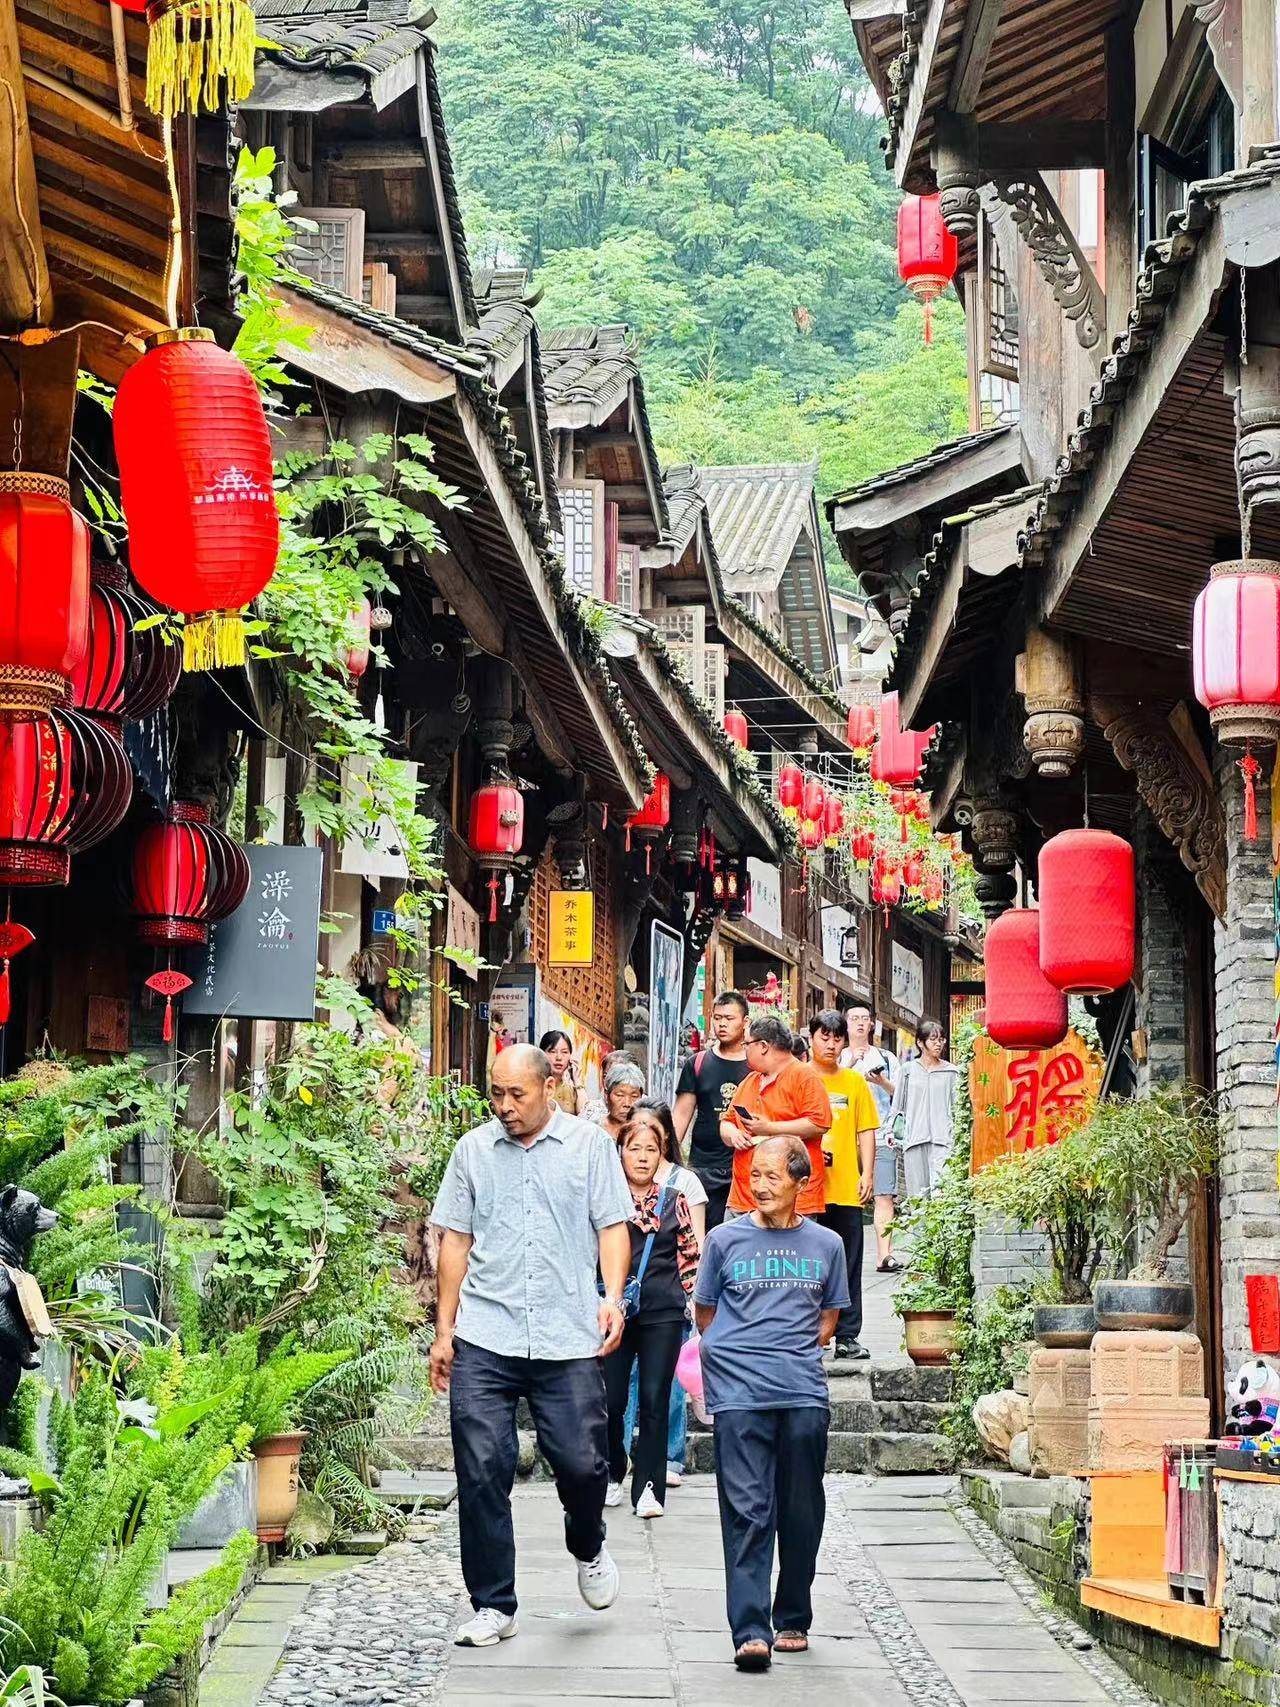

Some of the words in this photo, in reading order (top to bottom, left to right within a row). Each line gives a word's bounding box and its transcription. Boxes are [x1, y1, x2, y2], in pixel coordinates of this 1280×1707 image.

[564, 900, 577, 950] 乔木茶事
[732, 1257, 823, 1282] PLANET
[758, 1281, 788, 1289] CLEAN
[793, 1281, 822, 1290] PLANET
